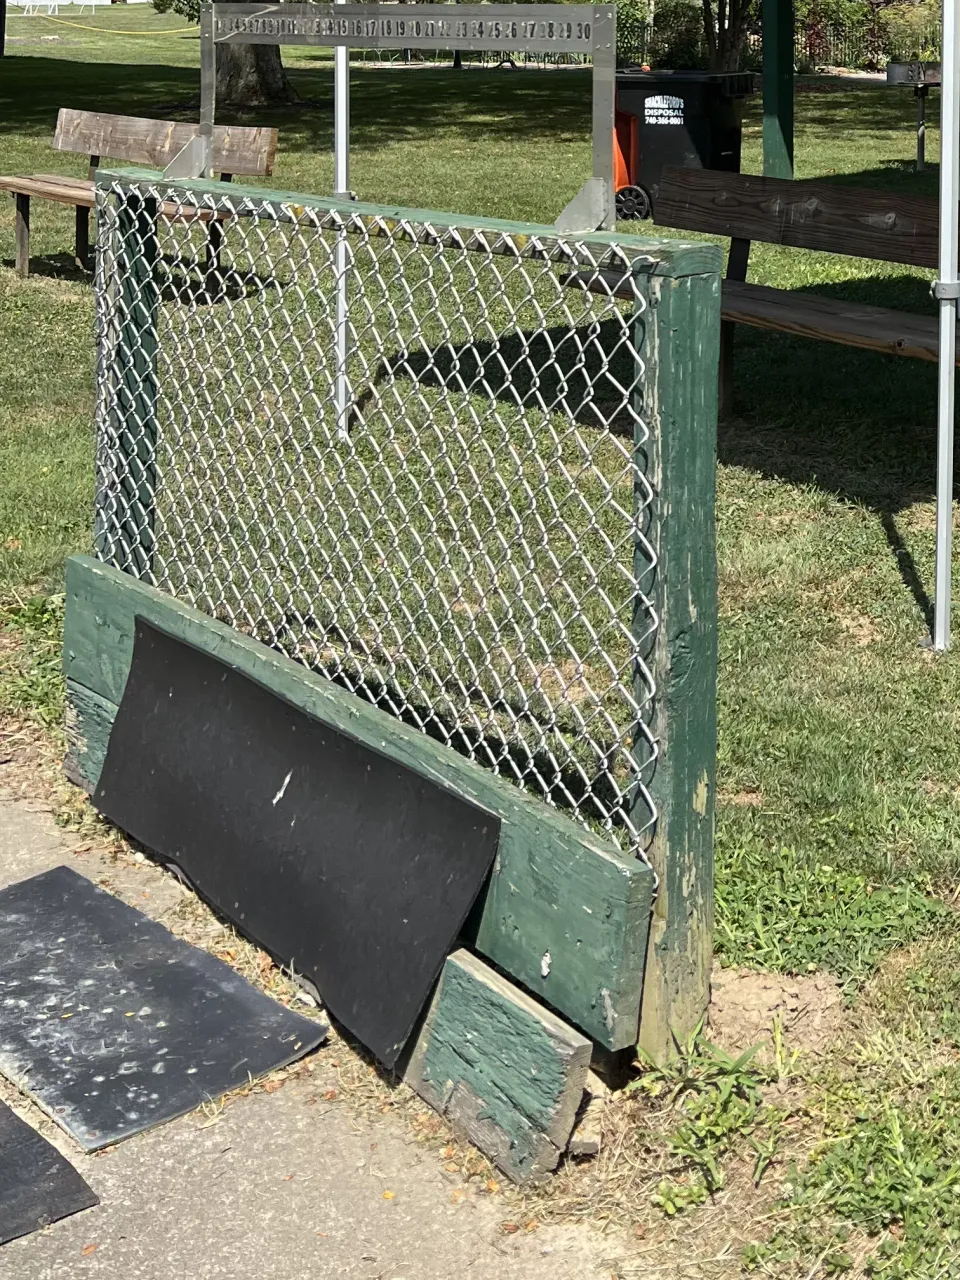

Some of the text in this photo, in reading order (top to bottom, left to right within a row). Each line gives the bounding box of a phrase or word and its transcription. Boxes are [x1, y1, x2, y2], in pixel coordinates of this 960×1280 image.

[337, 19, 347, 36] 15
[352, 19, 362, 36] 16
[365, 20, 376, 36] 17
[381, 20, 391, 37] 18
[396, 21, 405, 36] 19
[425, 21, 435, 37] 21
[456, 22, 467, 38] 23
[472, 21, 484, 38] 24
[489, 21, 500, 38] 25
[505, 21, 517, 39] 26
[523, 22, 536, 39] 27
[541, 22, 554, 39] 28
[559, 22, 572, 39] 29
[577, 22, 591, 40] 30
[644, 95, 684, 108] SHACKLEFORD'S
[644, 108, 684, 116] DISPOSAL
